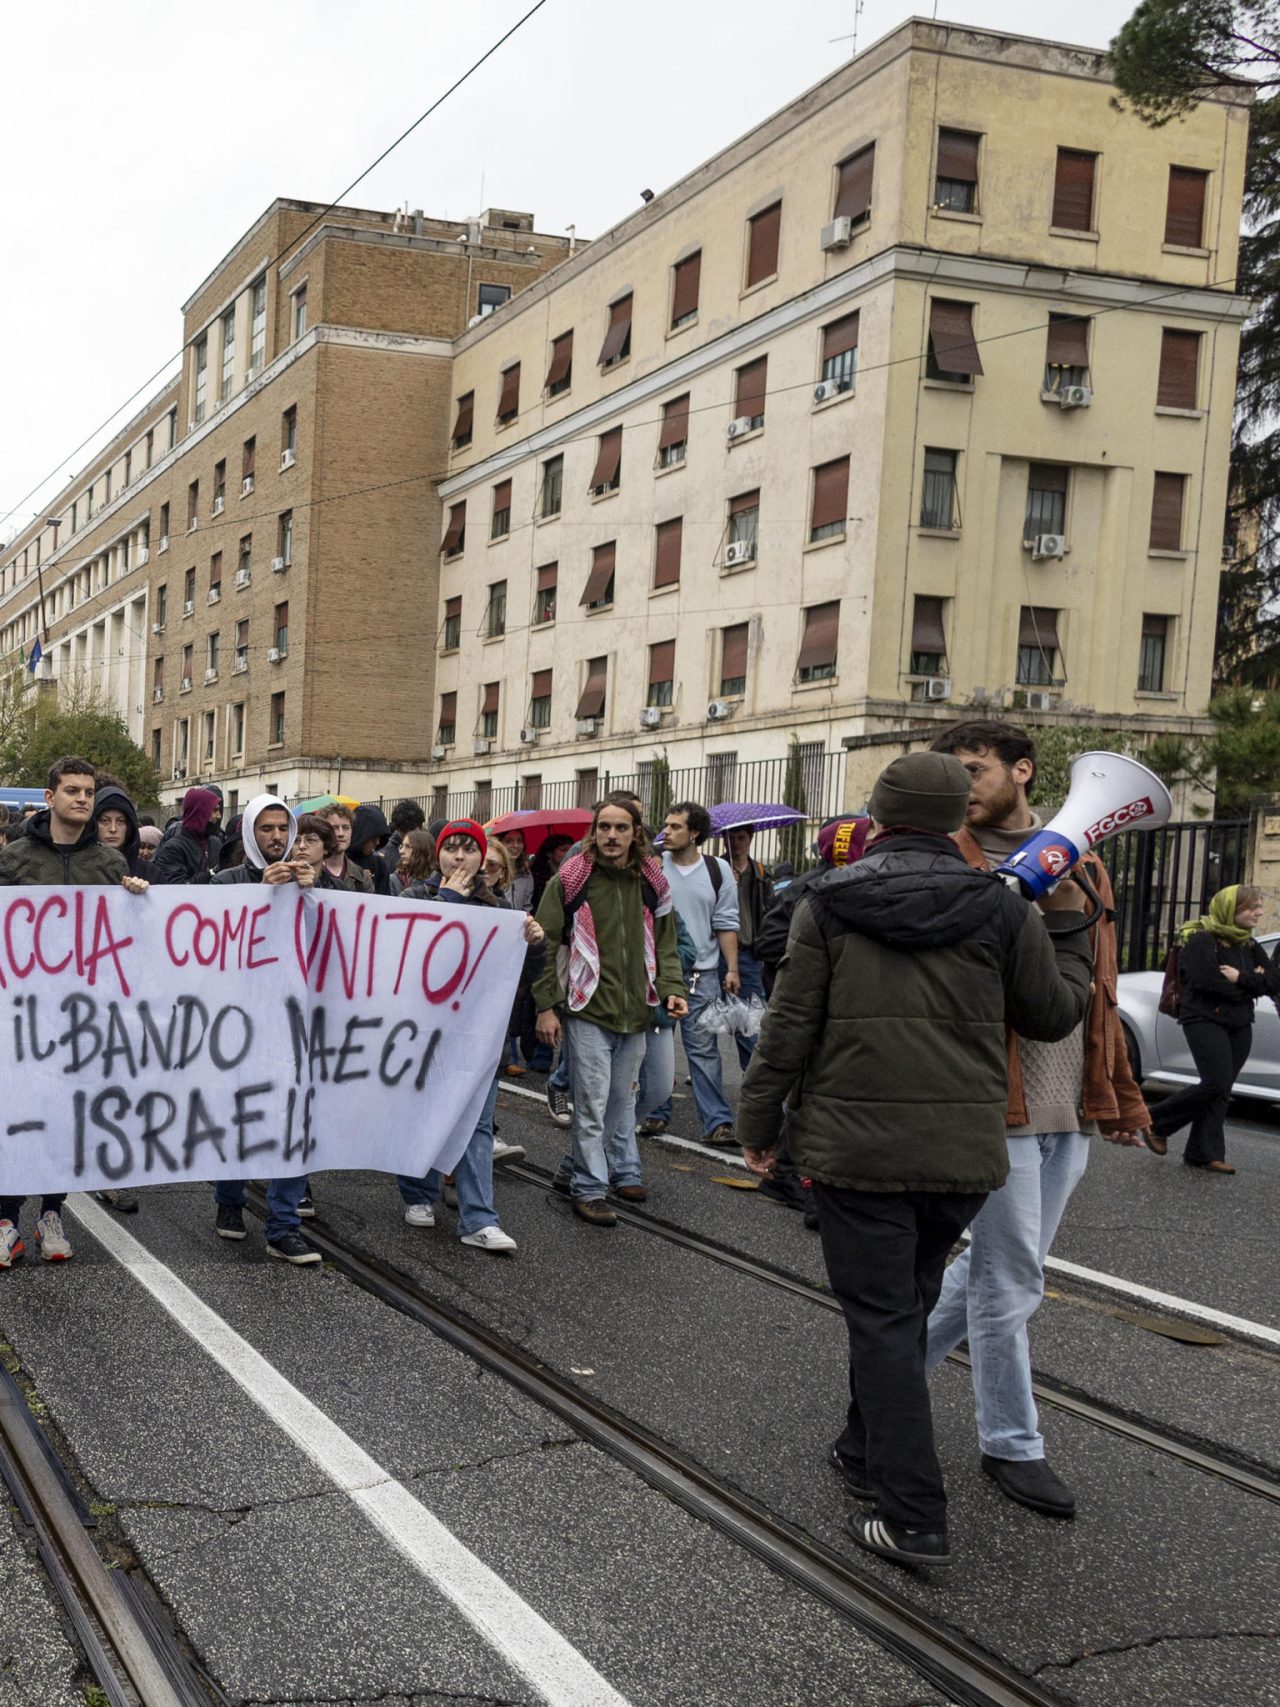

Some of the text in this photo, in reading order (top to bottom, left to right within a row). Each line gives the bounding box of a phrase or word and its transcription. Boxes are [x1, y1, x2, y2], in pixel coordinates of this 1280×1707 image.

[165, 903, 279, 971] COME
[294, 896, 498, 1011] UNITO!
[59, 992, 254, 1079] BANDO
